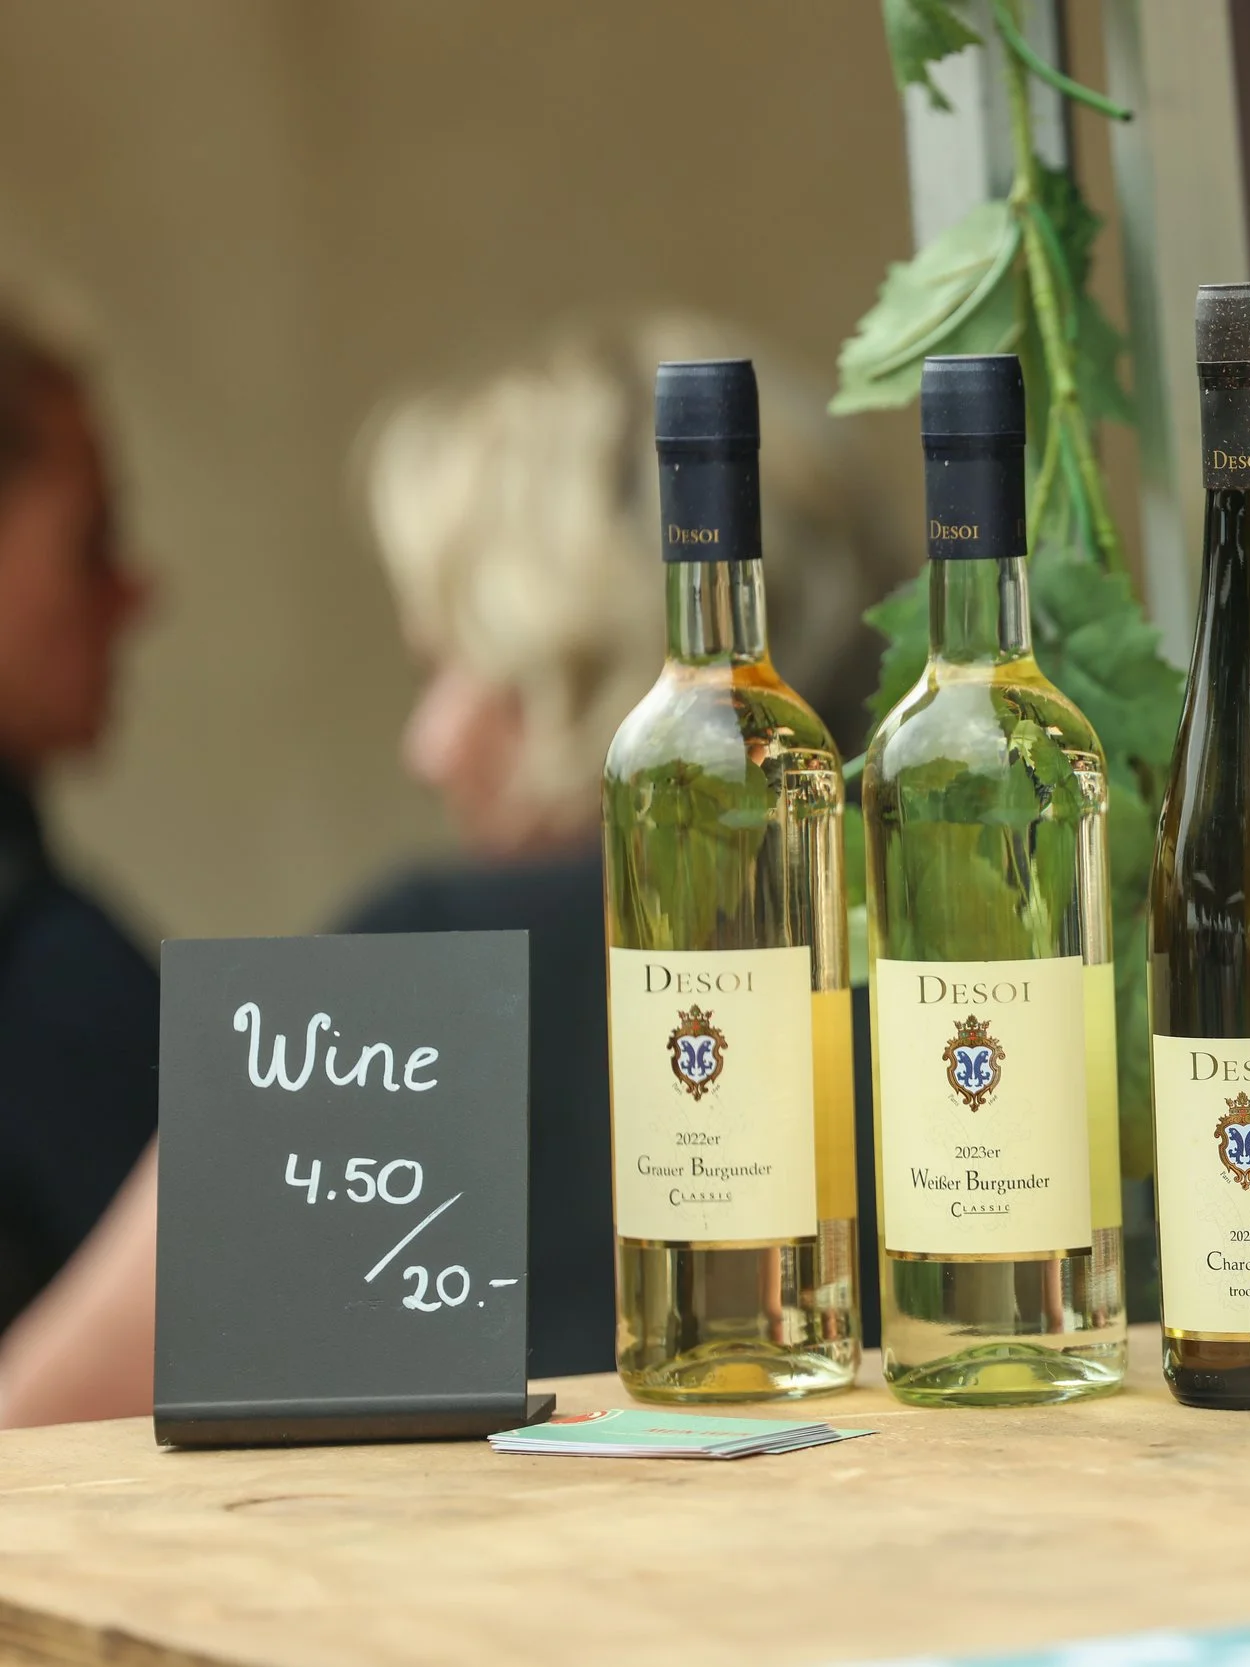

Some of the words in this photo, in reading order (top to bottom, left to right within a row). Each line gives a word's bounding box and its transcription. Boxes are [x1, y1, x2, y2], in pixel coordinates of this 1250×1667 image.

[644, 963, 755, 994] DESOI
[917, 975, 1032, 1005] DESOI
[233, 1002, 439, 1092] Wine
[675, 1132, 721, 1146] 2022er
[955, 1146, 1001, 1159] 2023er
[285, 1153, 423, 1205] 4.50
[637, 1155, 684, 1178] Grauer
[691, 1156, 773, 1181] Burgunder
[911, 1167, 961, 1191] Weißer
[966, 1170, 1050, 1195] Burgunder
